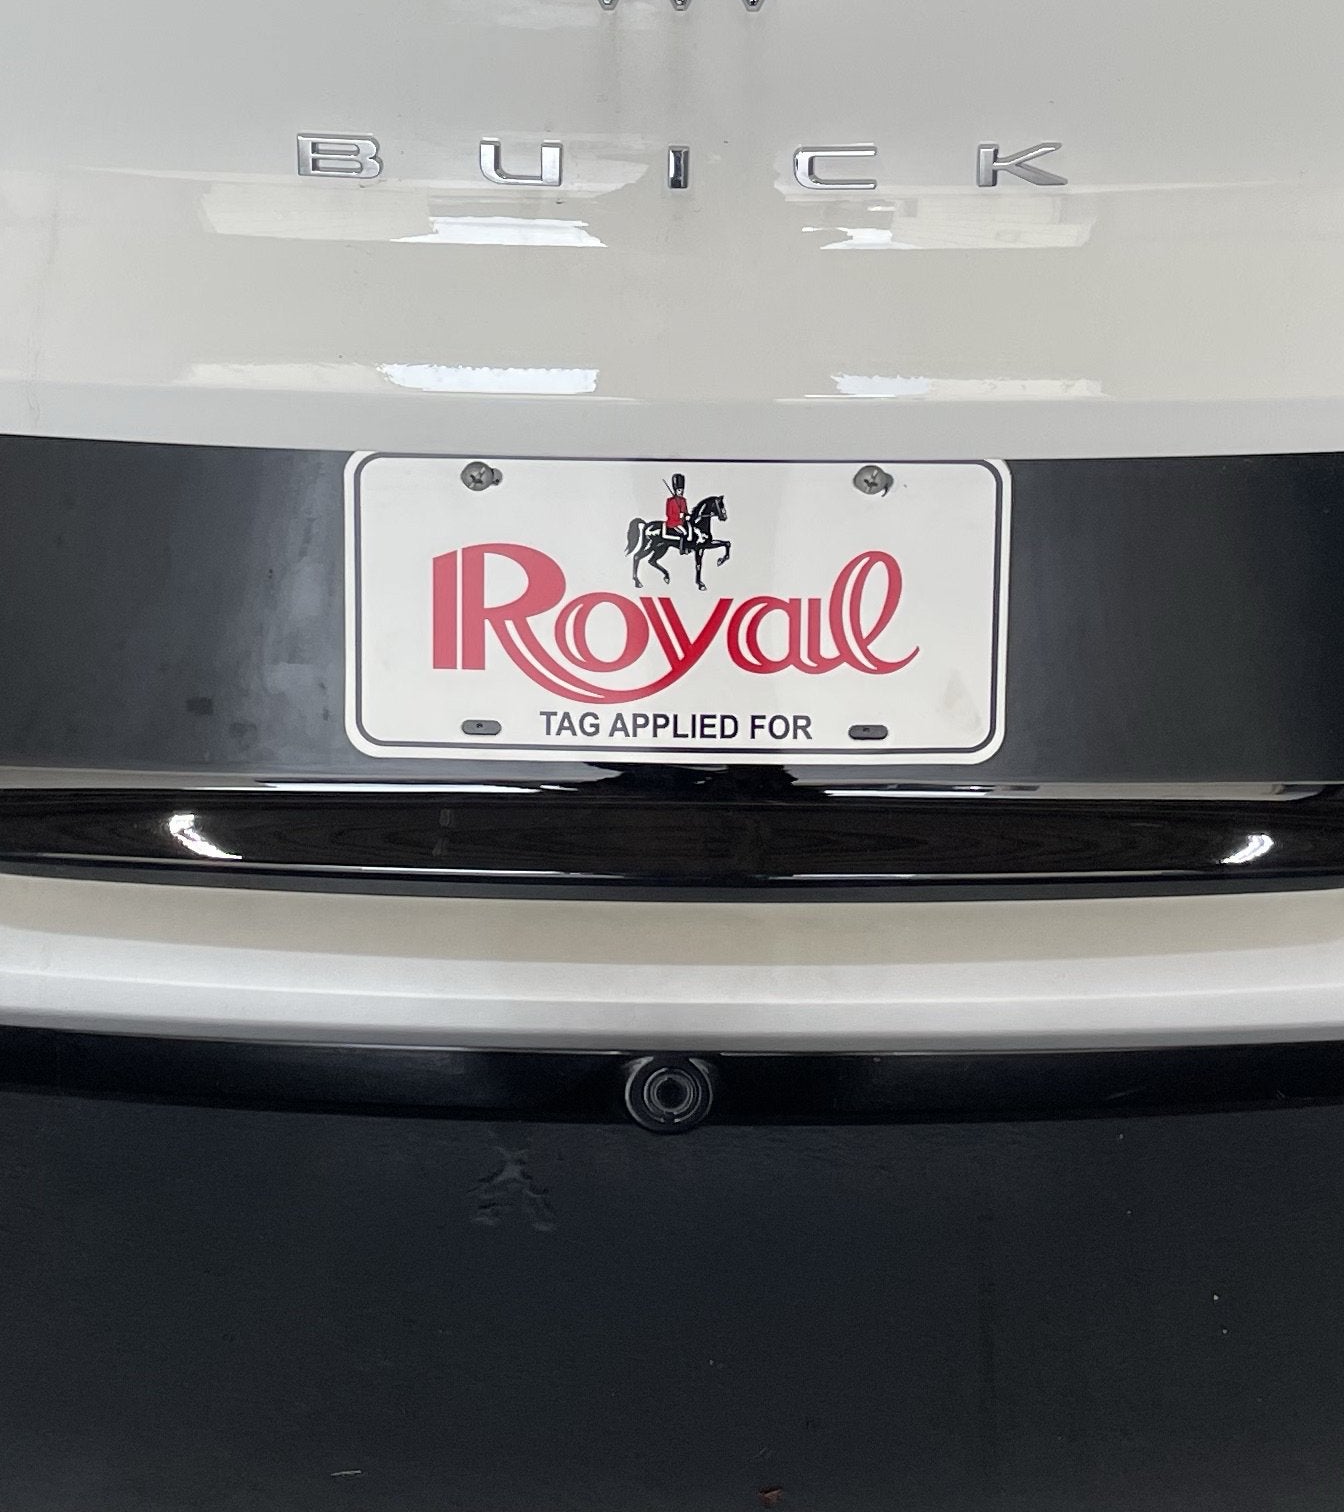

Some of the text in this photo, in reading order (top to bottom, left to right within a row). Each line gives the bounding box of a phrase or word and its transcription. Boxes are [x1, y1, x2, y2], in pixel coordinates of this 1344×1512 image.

[296, 133, 1069, 190] BUICK
[432, 543, 920, 704] Royal
[540, 711, 813, 740] TAG APPLIED FOR
